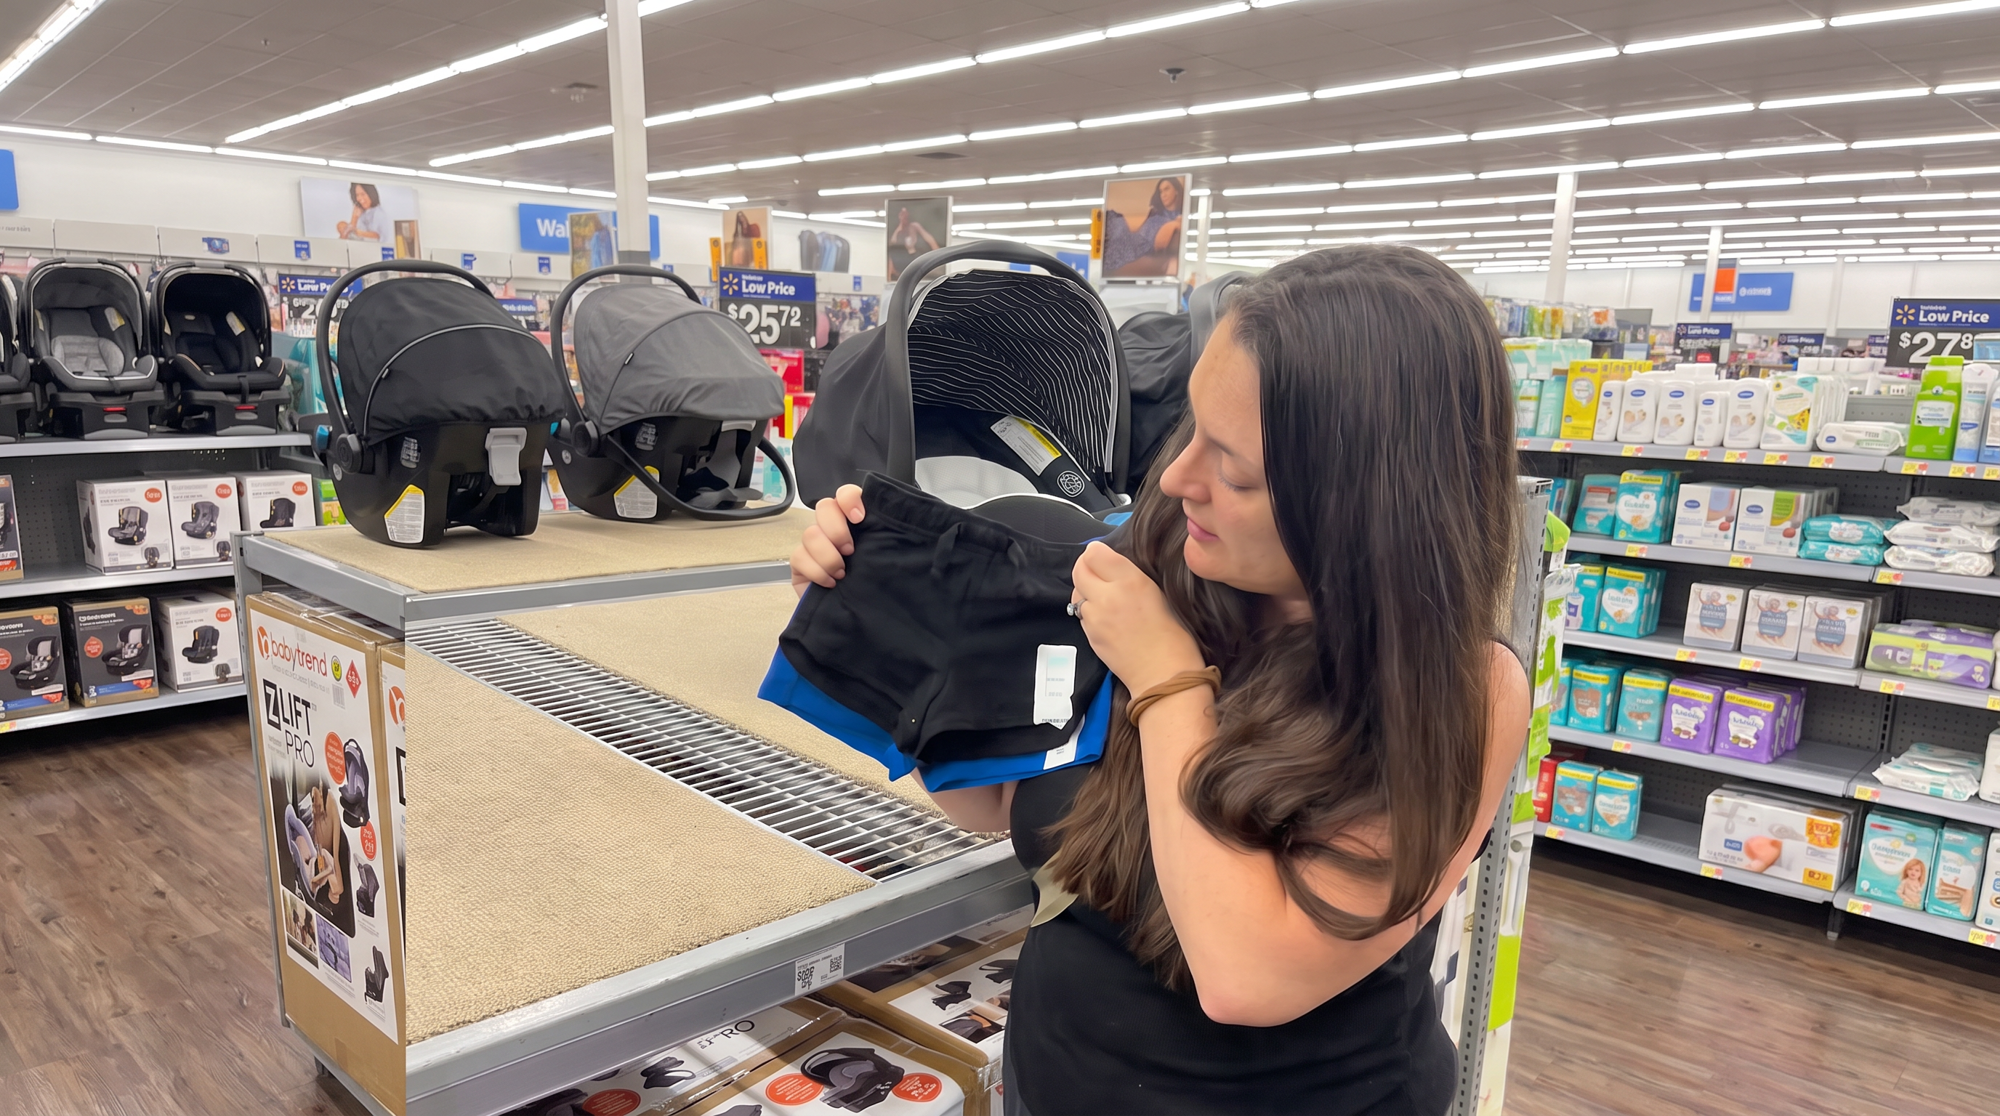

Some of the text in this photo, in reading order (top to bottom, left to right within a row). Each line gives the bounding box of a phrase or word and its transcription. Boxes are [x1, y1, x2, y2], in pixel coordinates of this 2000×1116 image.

[742, 280, 796, 296] Low Price
[1919, 309, 1990, 323] Low Price
[270, 632, 327, 677] babytrend
[285, 729, 315, 769] PRO
